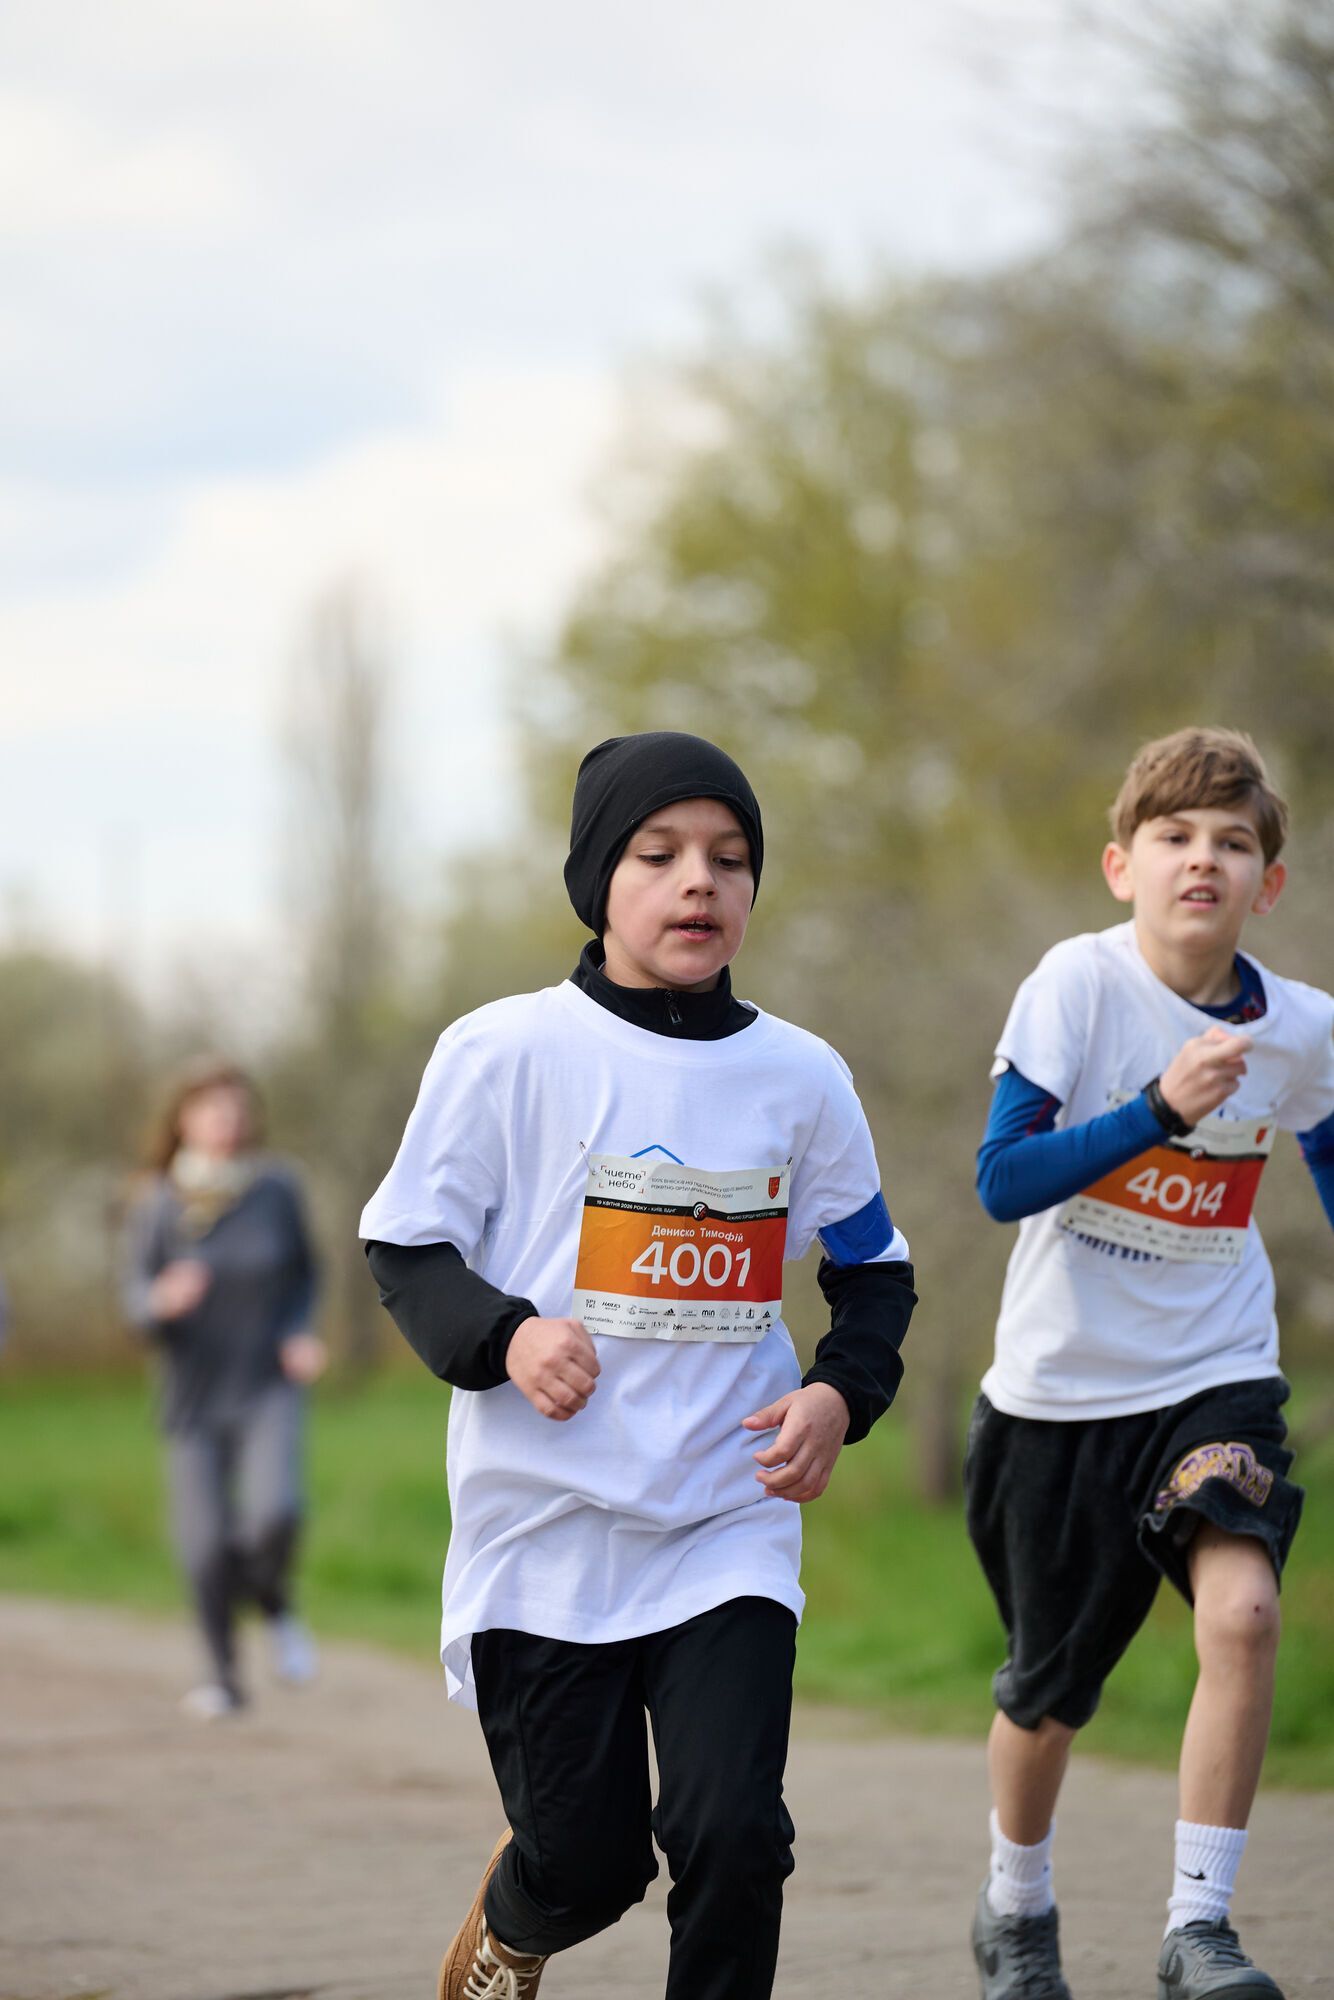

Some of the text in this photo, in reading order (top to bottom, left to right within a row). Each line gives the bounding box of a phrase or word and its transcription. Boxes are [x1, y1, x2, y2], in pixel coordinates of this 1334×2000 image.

[604, 1169, 642, 1181] чисте
[608, 1179, 636, 1190] небо
[1125, 1166, 1227, 1218] 4014
[651, 1225, 744, 1243] Дениско Тимофій
[631, 1240, 751, 1287] 4001
